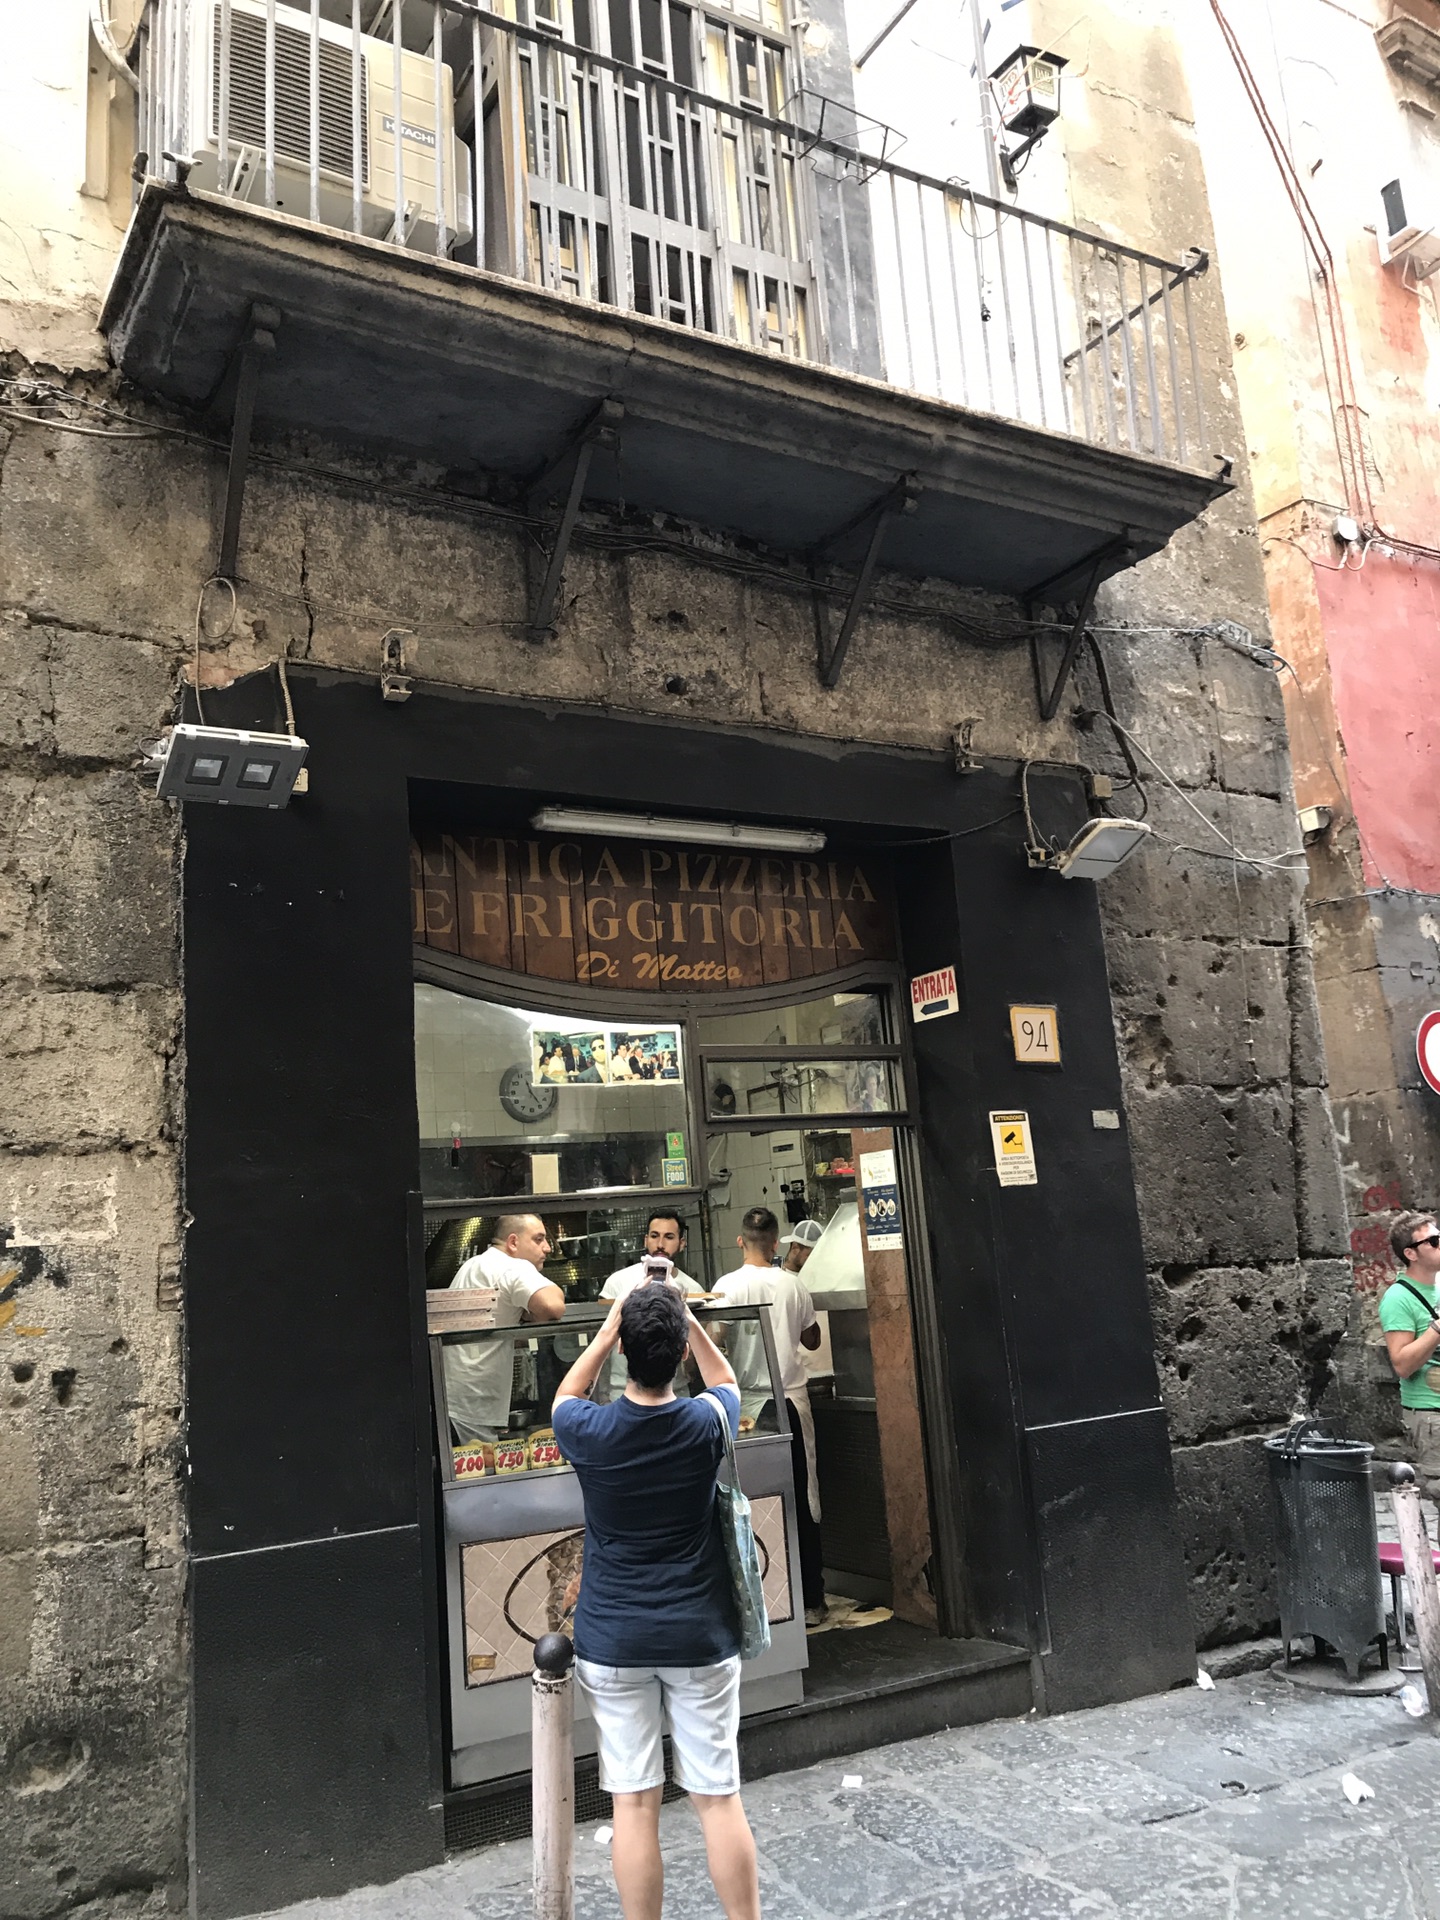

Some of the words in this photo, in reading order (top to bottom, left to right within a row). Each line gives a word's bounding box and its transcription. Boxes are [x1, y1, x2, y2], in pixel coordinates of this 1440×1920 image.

[386, 120, 434, 145] HTACHI
[641, 849, 877, 903] PIZZERIA
[411, 887, 454, 934] E
[471, 890, 865, 951] FRIGGITORIA
[577, 951, 621, 980] Di
[632, 951, 743, 982] Matteo
[911, 970, 956, 1004] ENTRATA
[1021, 1020, 1049, 1053] 94
[667, 1172, 684, 1181] FOOD
[454, 1456, 484, 1474] 1.00
